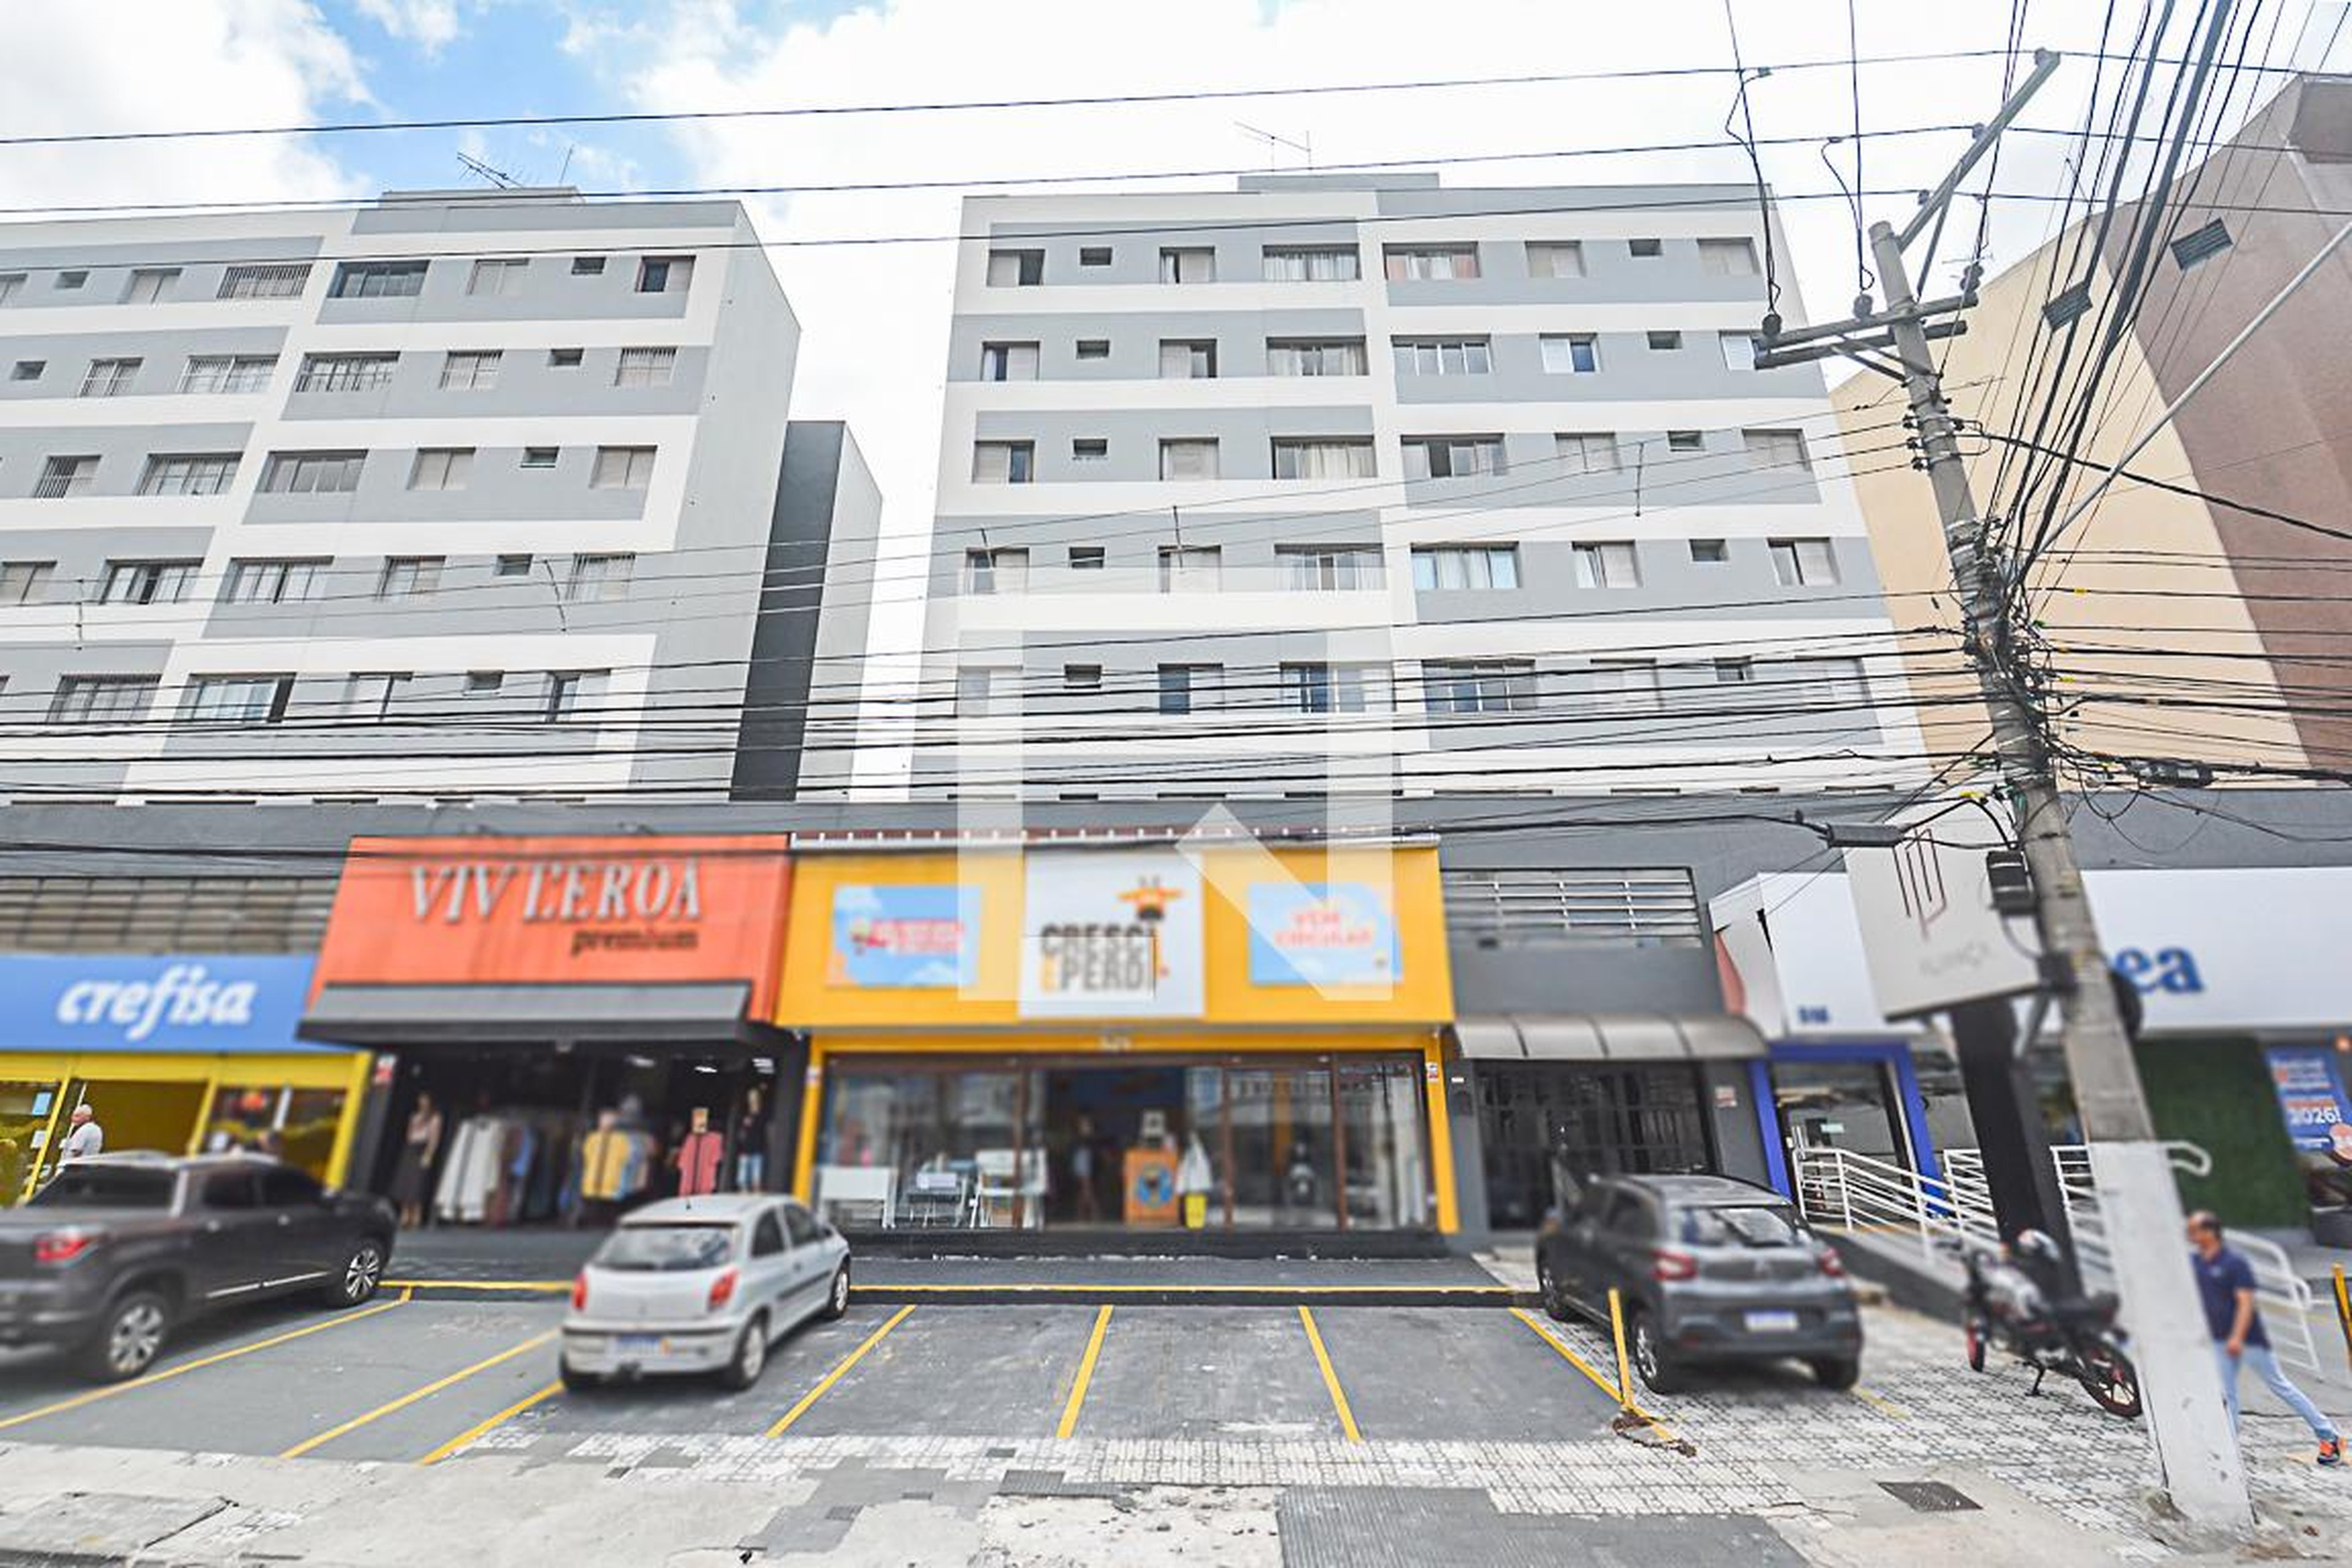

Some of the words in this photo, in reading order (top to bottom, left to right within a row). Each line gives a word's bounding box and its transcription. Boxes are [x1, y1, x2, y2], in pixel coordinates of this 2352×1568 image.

[412, 865, 519, 922] VIV
[571, 930, 700, 957] premium
[2115, 946, 2205, 994] ea
[58, 963, 257, 1040] crefisa
